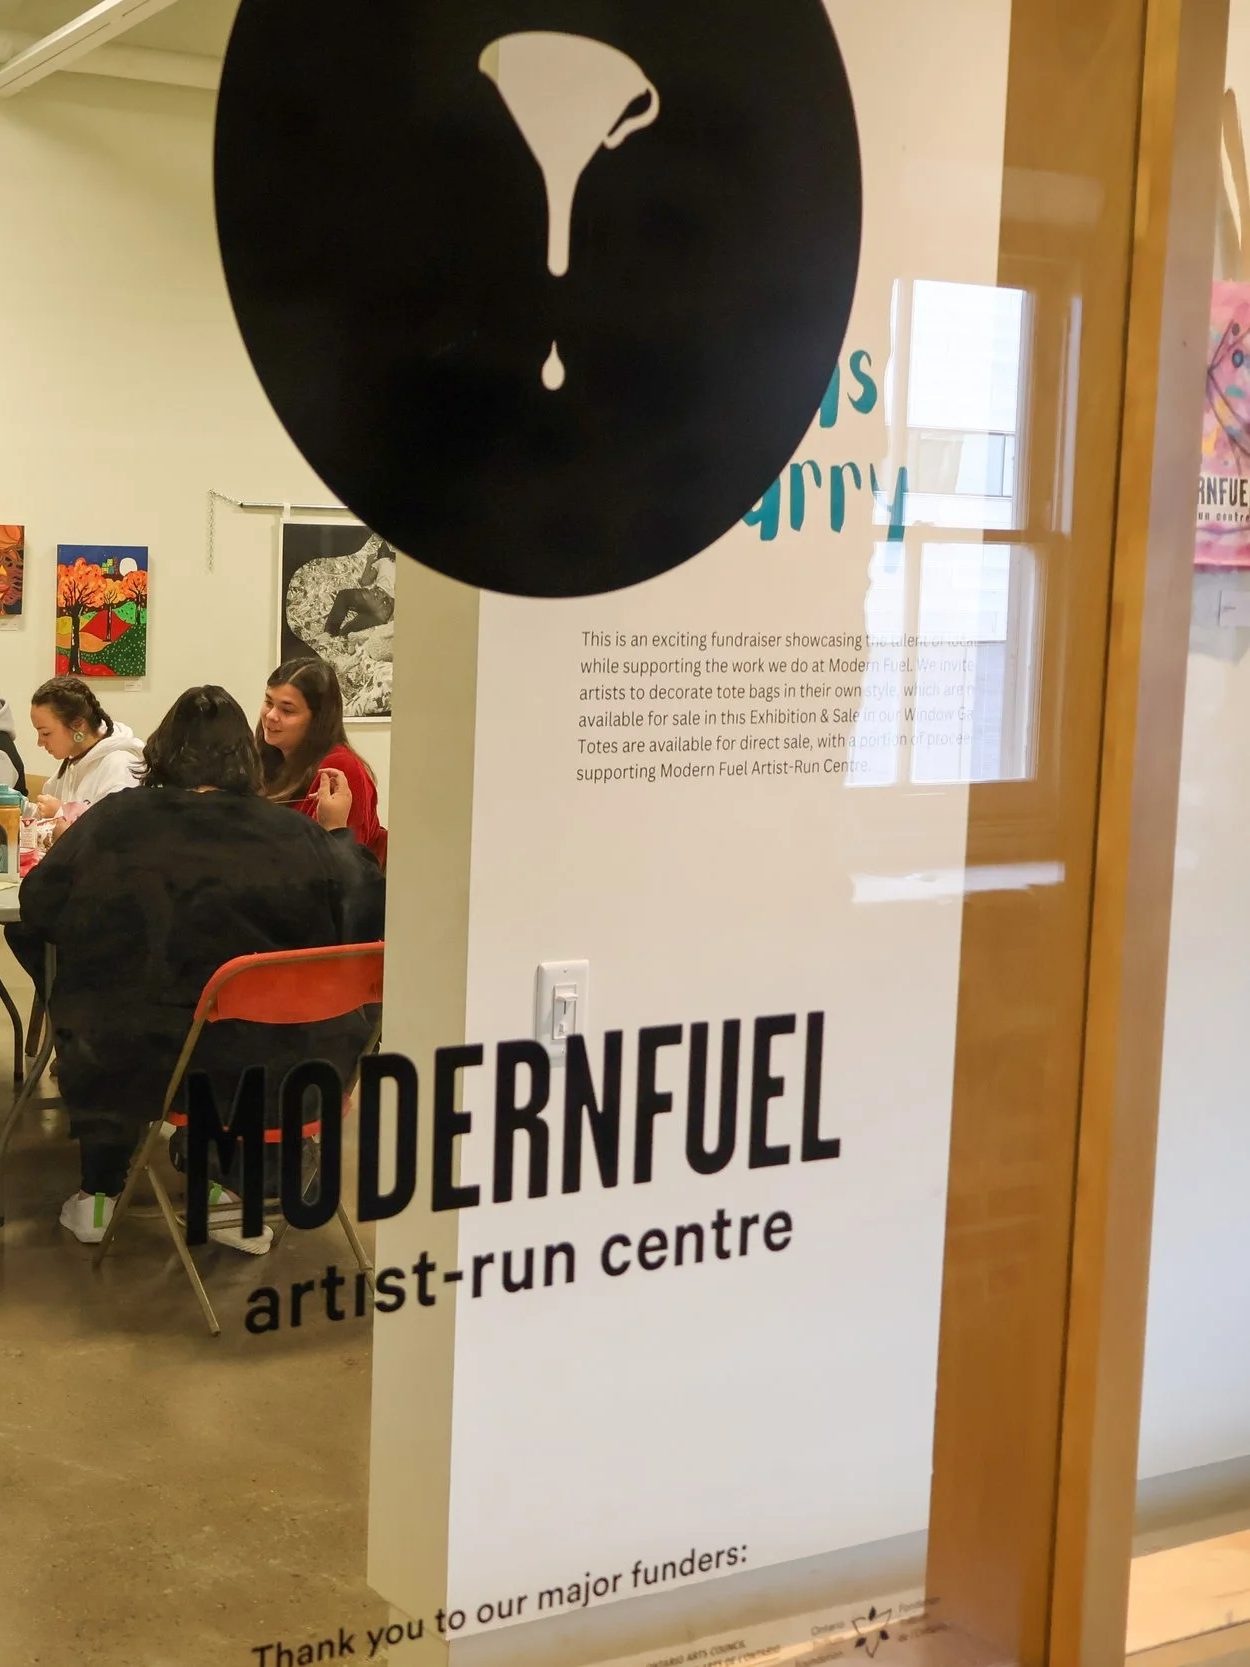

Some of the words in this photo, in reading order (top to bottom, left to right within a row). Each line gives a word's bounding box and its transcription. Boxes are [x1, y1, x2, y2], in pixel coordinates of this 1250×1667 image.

[582, 631, 611, 647] This
[615, 631, 626, 647] is
[630, 634, 648, 647] an
[652, 631, 707, 651] exciting
[711, 631, 782, 647] fundraiser
[785, 632, 862, 651] showcasing
[581, 658, 619, 673] while
[623, 658, 701, 677] supporting
[705, 658, 728, 673] the
[732, 658, 764, 673] work
[768, 660, 787, 673] we
[791, 658, 808, 673] do
[812, 660, 824, 673] at
[829, 658, 879, 673] Modern
[883, 657, 913, 673] Fuel.
[916, 657, 935, 672] We
[579, 685, 626, 700] artists
[630, 686, 645, 700] to
[649, 684, 713, 699] decorate
[717, 685, 745, 699] tote
[749, 683, 780, 702] bags
[784, 684, 796, 697] in
[800, 683, 831, 697] their
[835, 685, 862, 697] own
[904, 682, 939, 696] which
[944, 684, 963, 696] are
[578, 711, 644, 727] available
[647, 710, 668, 726] for
[672, 710, 701, 726] sale
[704, 711, 717, 725] in
[721, 710, 746, 725] this
[750, 709, 816, 724] Exhibition
[820, 709, 829, 723] &
[832, 708, 860, 723] Sale
[864, 708, 876, 722] in
[879, 709, 901, 722] our
[904, 707, 953, 722] Window
[578, 739, 618, 754] Totes
[622, 740, 645, 753] are
[649, 736, 712, 752] available
[716, 735, 736, 751] for
[740, 735, 780, 751] direct
[783, 735, 813, 751] sale,
[817, 734, 845, 748] with
[849, 736, 856, 747] a
[860, 733, 907, 750] portion
[911, 732, 925, 746] of
[576, 764, 656, 784] supporting
[660, 763, 715, 779] Modern
[719, 760, 748, 776] Fuel
[752, 759, 819, 775] Artist-Run
[823, 758, 871, 773] Centre.
[186, 1010, 841, 1247] MODERNFUEL
[245, 1237, 576, 1335] artist-run
[601, 1208, 794, 1277] centre
[252, 1628, 356, 1667] Thank
[367, 1618, 425, 1661] you
[435, 1607, 466, 1632] to
[476, 1594, 529, 1625] our
[537, 1570, 624, 1609] major
[630, 1544, 748, 1588] funders:
